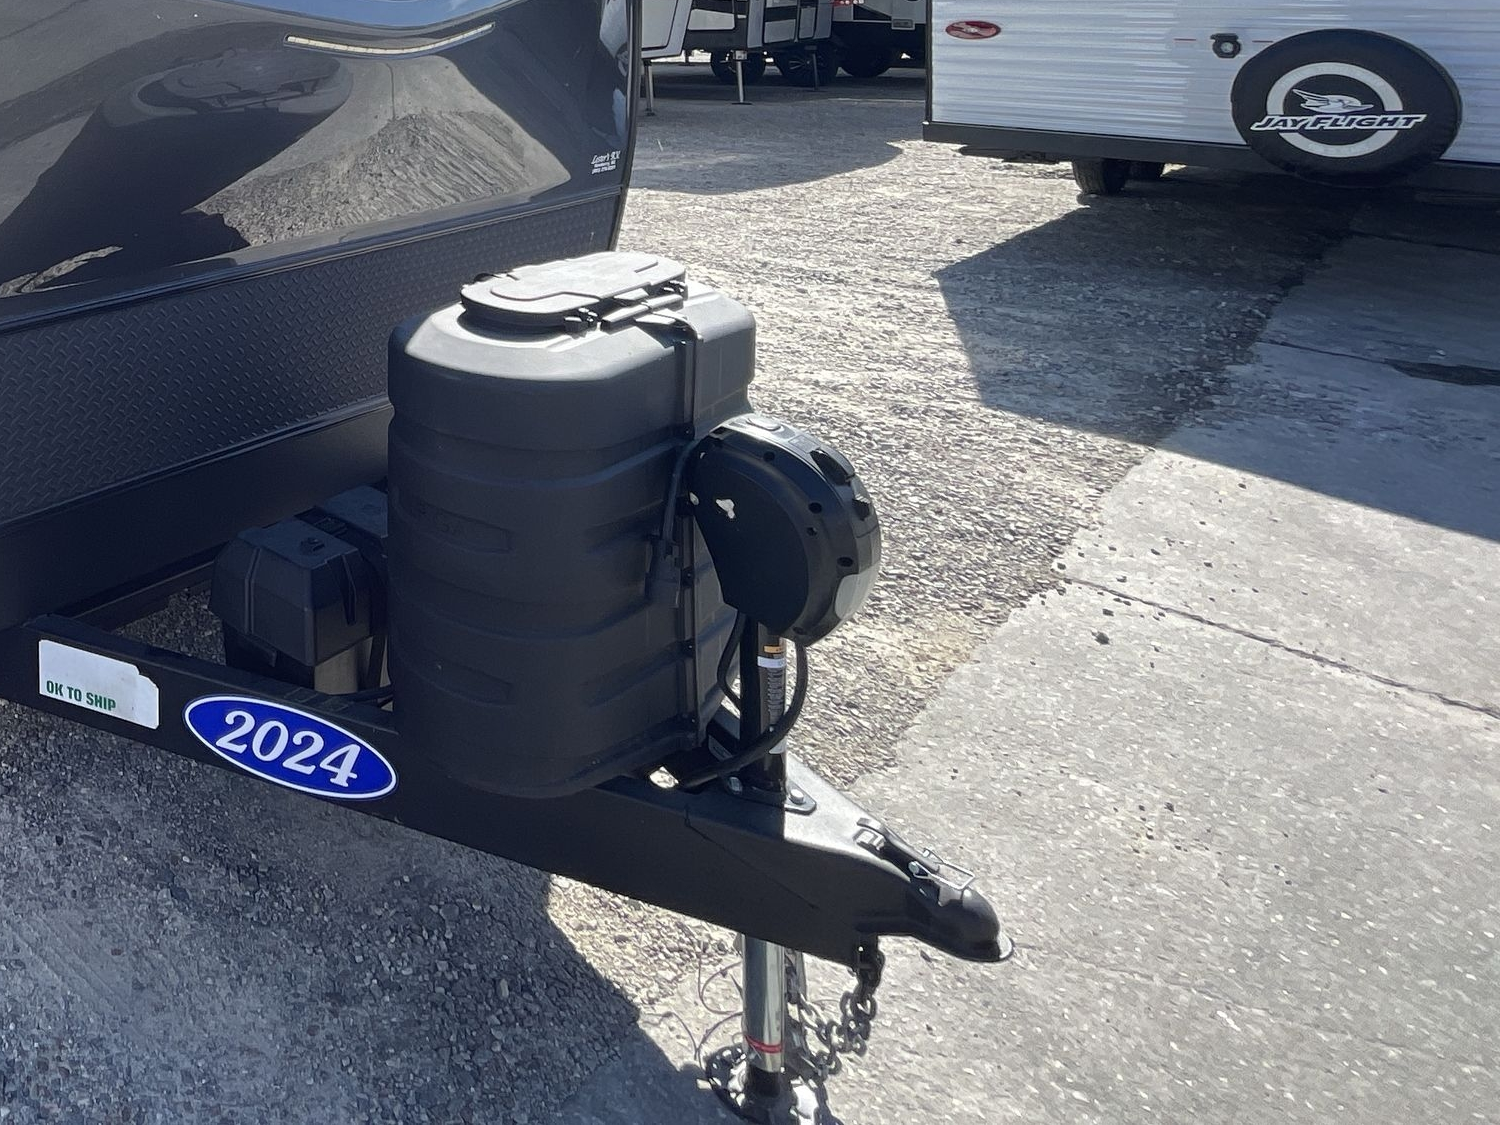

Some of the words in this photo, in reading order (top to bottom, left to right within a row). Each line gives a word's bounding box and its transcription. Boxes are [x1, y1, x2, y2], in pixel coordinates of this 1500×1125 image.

[46, 680, 64, 695] OK
[66, 686, 83, 702] TO
[86, 692, 116, 711] SHIP
[216, 710, 361, 787] 2024
